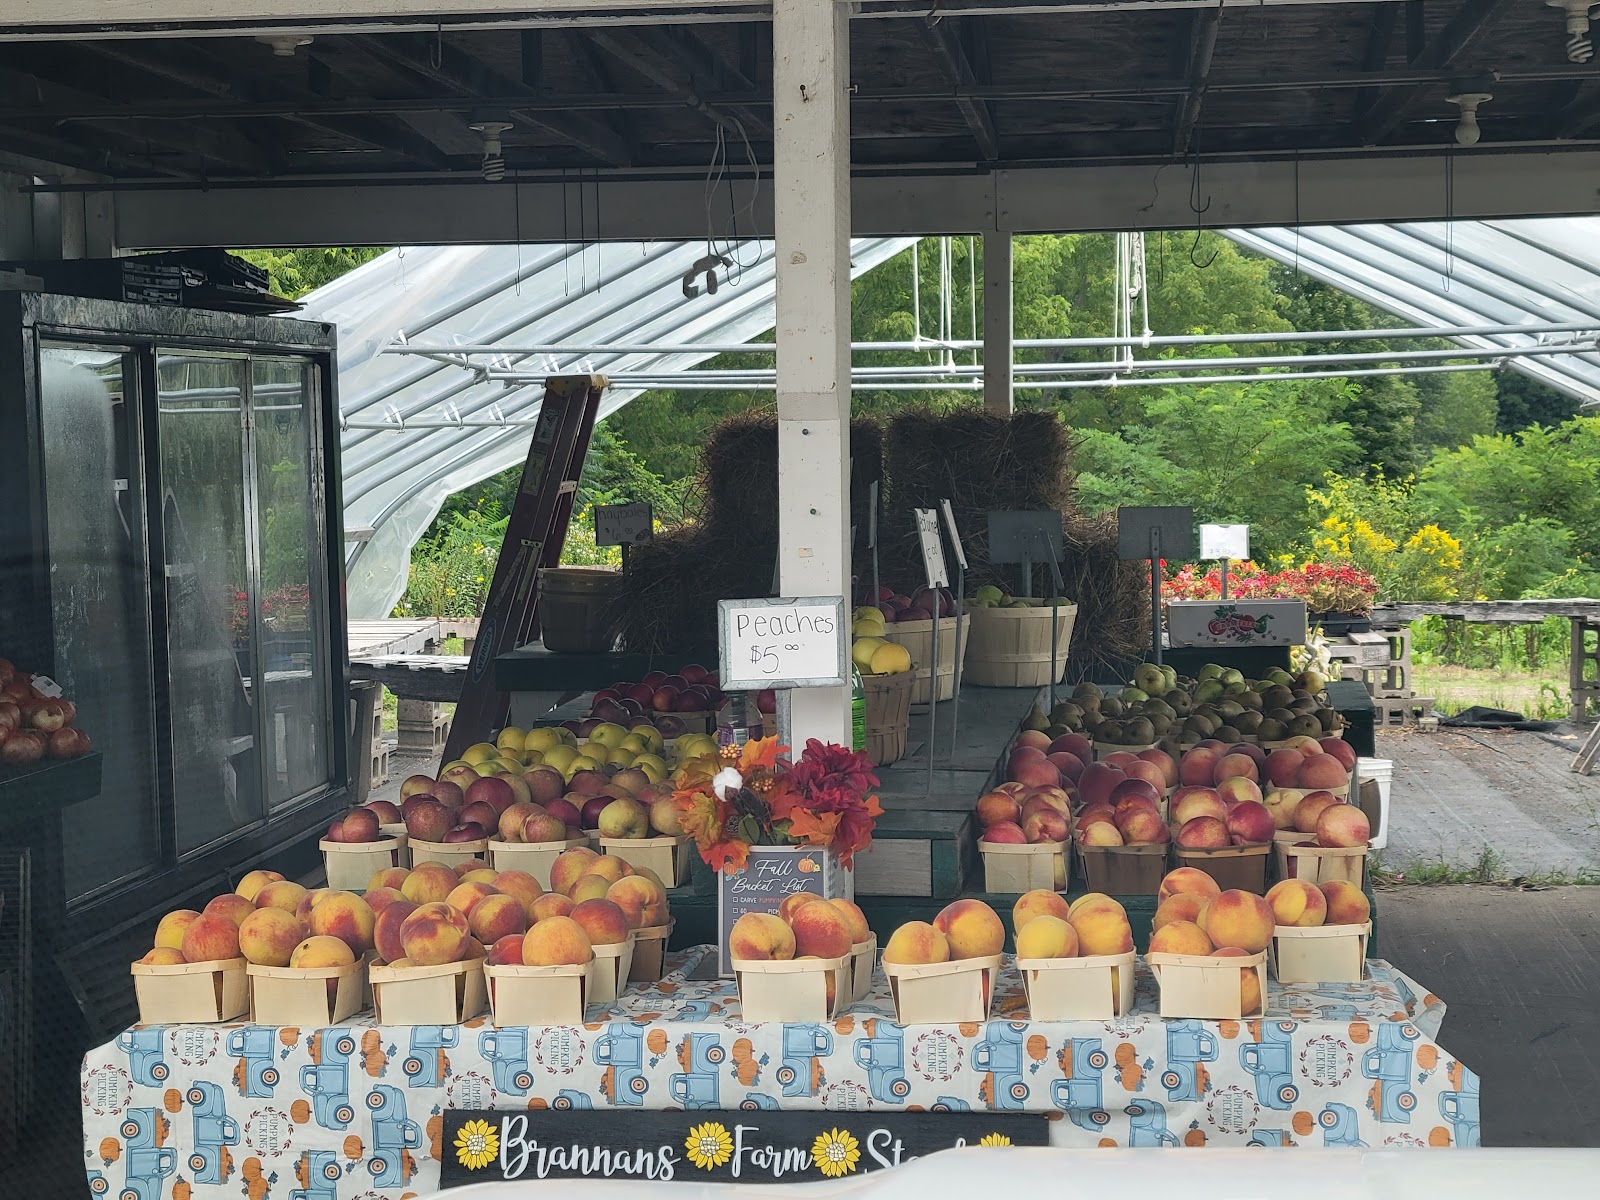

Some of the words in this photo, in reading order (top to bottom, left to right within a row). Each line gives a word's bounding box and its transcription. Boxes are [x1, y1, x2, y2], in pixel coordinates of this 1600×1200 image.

[597, 506, 648, 526] haybales
[737, 609, 834, 638] Peaches
[731, 877, 781, 894] Bucket
[780, 877, 815, 895] List
[754, 859, 793, 878] Fall
[740, 896, 757, 904] CARVE
[184, 1030, 195, 1057] CKING
[195, 1026, 206, 1060] UMPKIN
[550, 1030, 560, 1065] PICKING
[560, 1029, 570, 1068] PUMPKIN
[927, 1037, 937, 1073] PICKING
[937, 1035, 948, 1075] PUMPKIN
[1316, 1043, 1326, 1078] PICKING
[1327, 1041, 1337, 1081] PUMPKIN
[97, 1072, 107, 1107] PICKING
[108, 1070, 118, 1109] PUMPKIN
[836, 1087, 847, 1110] PICKI
[847, 1086, 858, 1110] PUMP
[1222, 1093, 1233, 1126] PICKING
[1233, 1092, 1244, 1129] PUMPKIN
[258, 1114, 268, 1149] PICKING
[269, 1112, 278, 1151] PUMPKIN
[500, 1114, 681, 1181] Brannans
[731, 1124, 813, 1179] Farm
